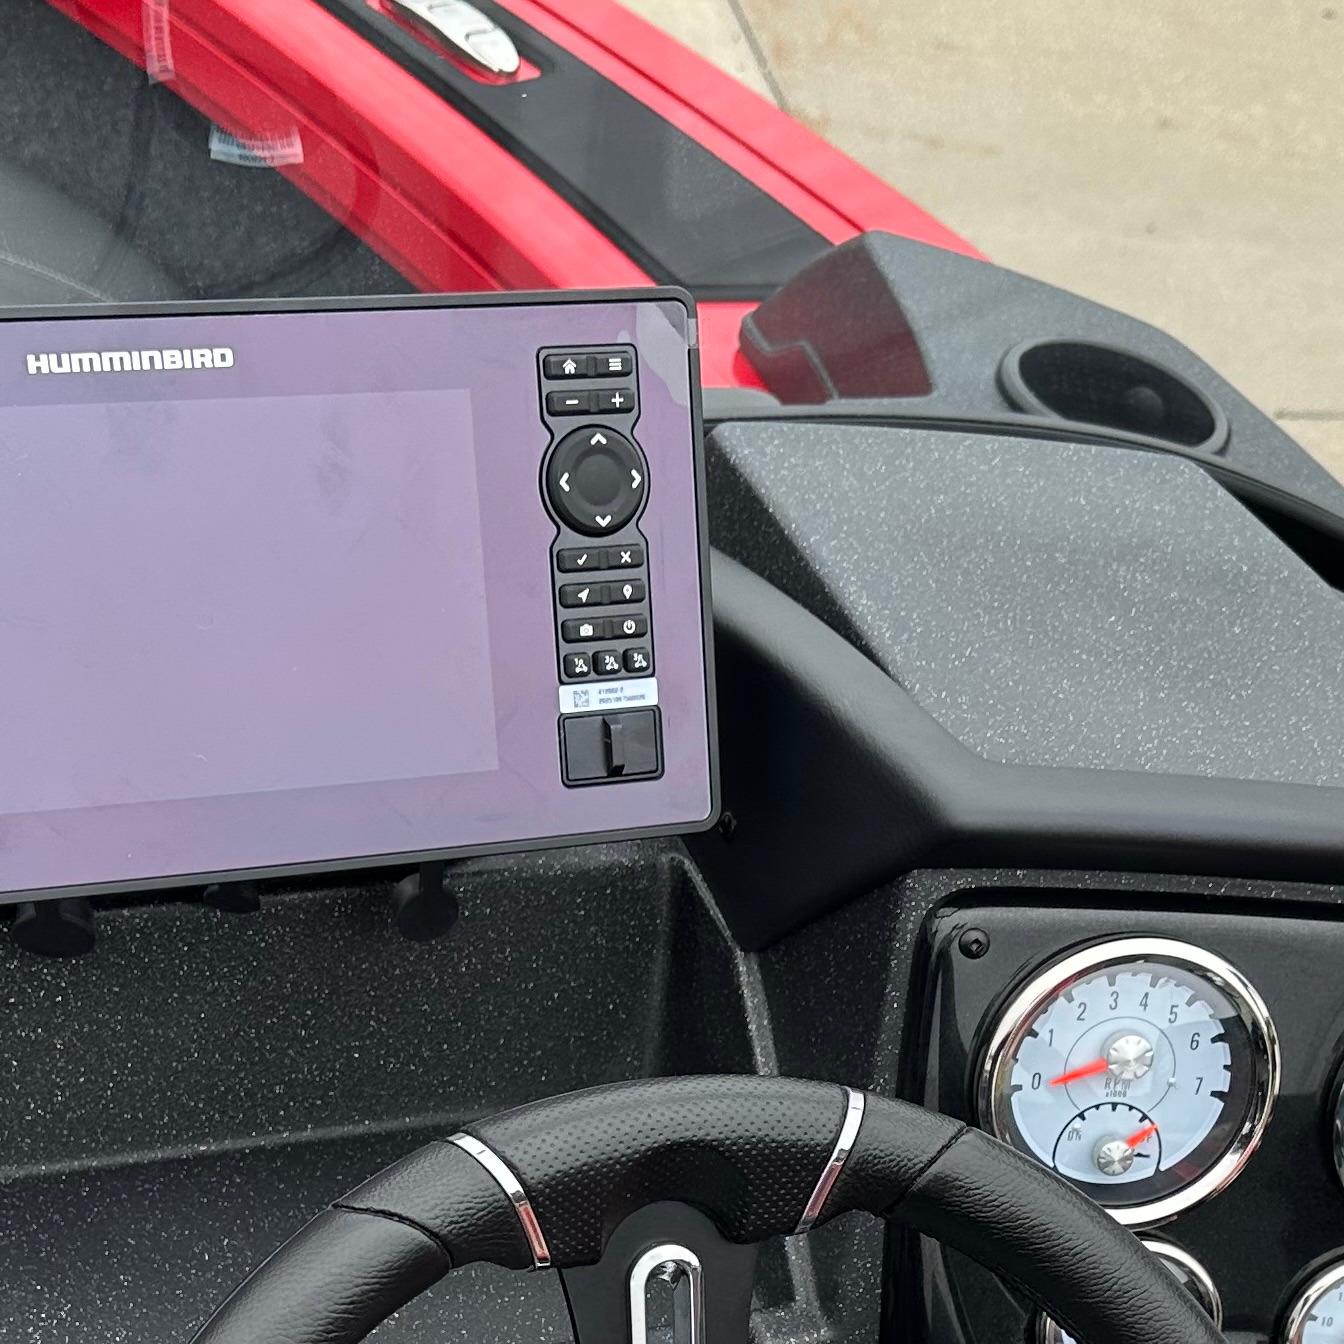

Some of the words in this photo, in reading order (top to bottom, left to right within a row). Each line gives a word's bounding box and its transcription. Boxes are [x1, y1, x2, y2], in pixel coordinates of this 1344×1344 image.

[26, 347, 234, 374] HUMMINBIRD
[1109, 991, 1119, 1010] 3
[1139, 992, 1149, 1011] 4
[1077, 1002, 1087, 1021] 2
[1168, 1004, 1179, 1024] 5
[1047, 1028, 1054, 1047] 1
[1190, 1032, 1200, 1051] 6
[1031, 1072, 1041, 1090] 0
[1104, 1077, 1131, 1090] RPM
[1194, 1077, 1204, 1095] 7
[1321, 1317, 1334, 1327] 10
